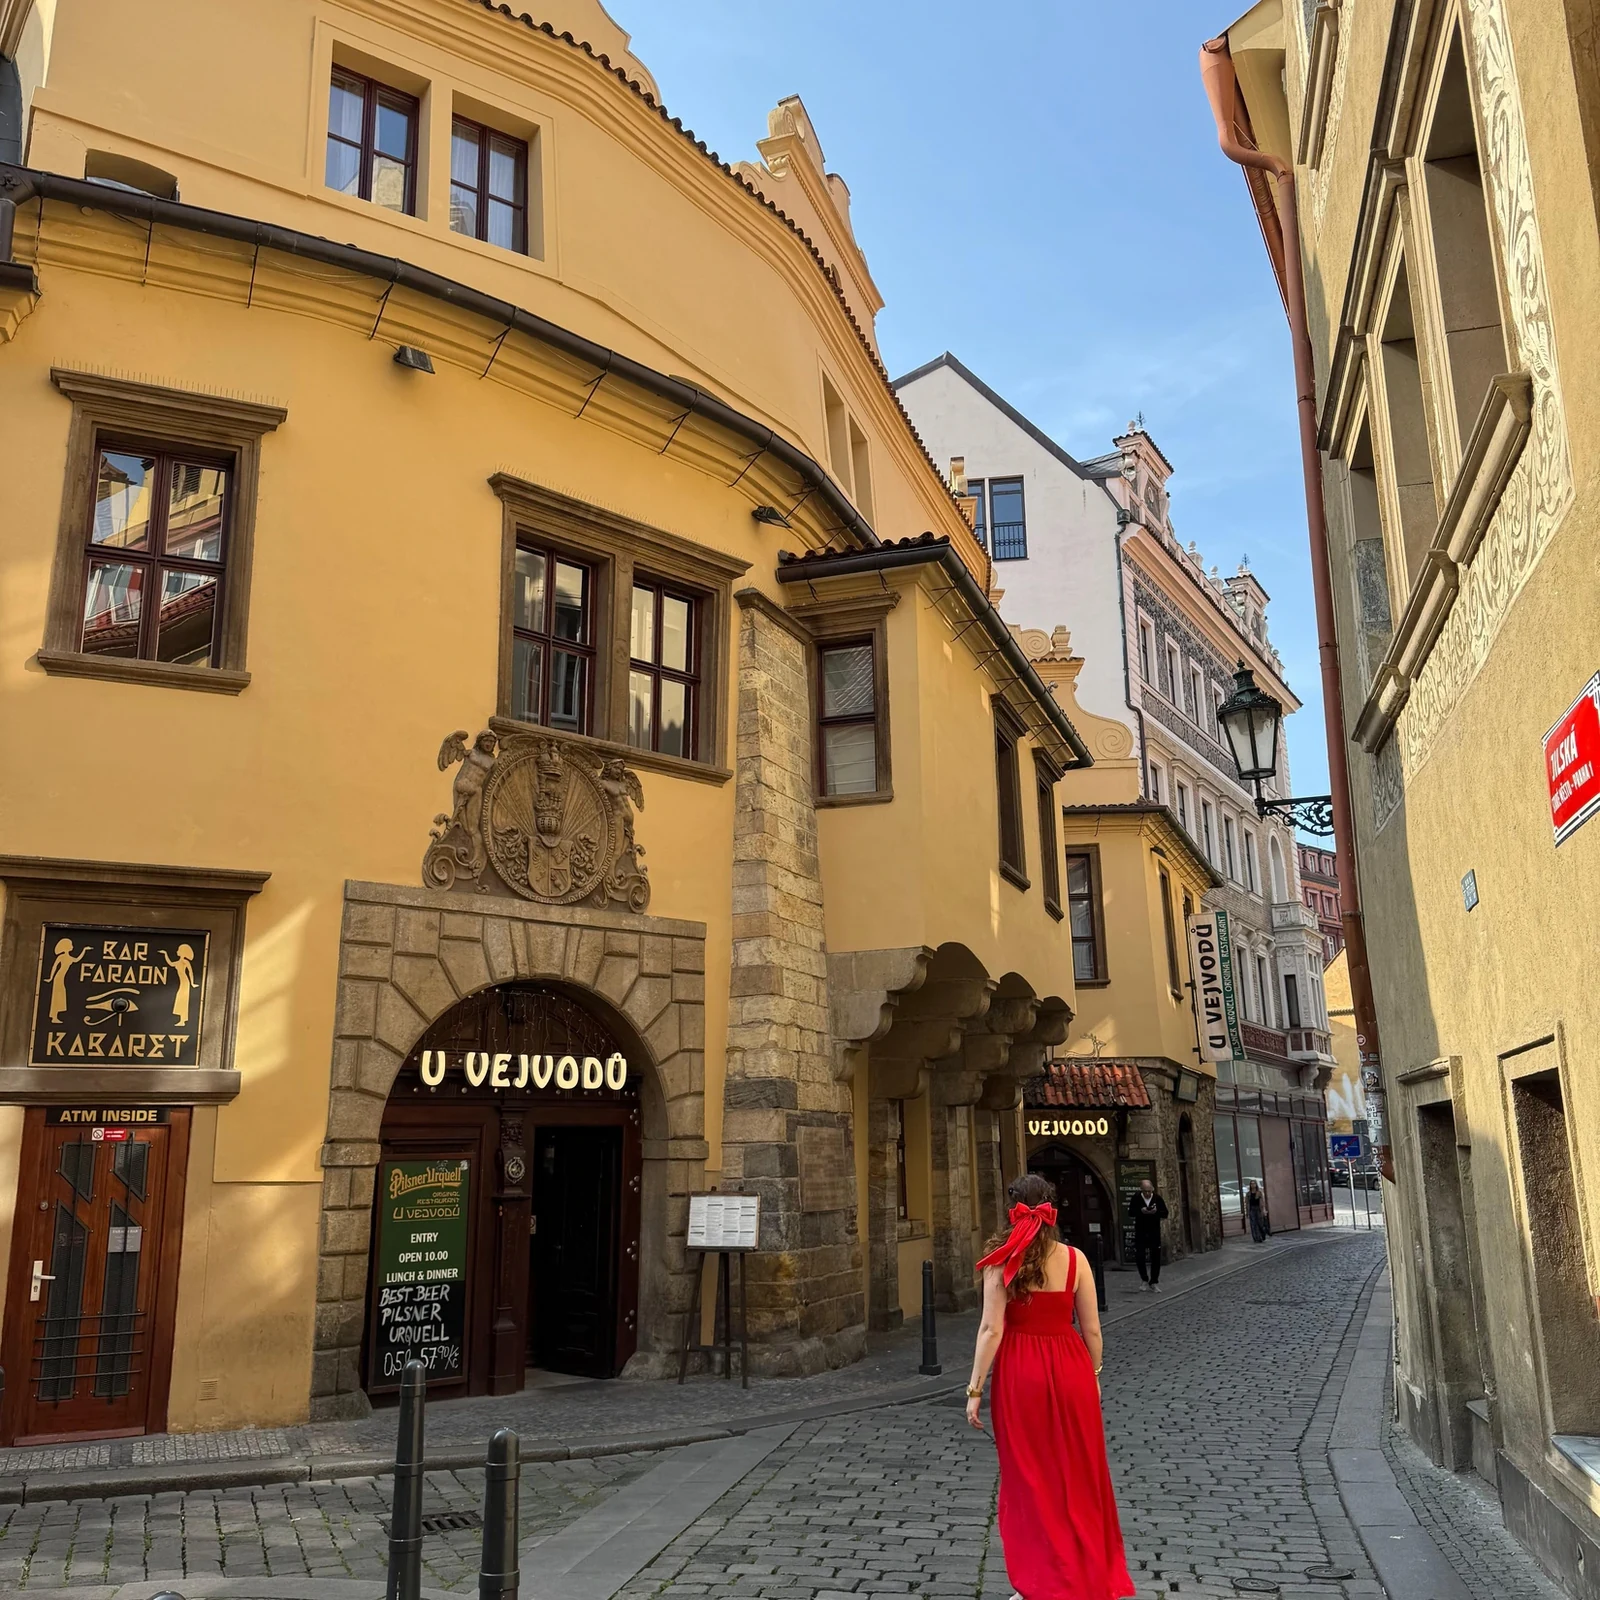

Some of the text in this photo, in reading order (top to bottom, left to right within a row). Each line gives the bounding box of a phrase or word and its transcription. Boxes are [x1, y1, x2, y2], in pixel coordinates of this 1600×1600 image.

[1550, 723, 1579, 782] JILSKÁ
[103, 940, 149, 961] BAR
[79, 963, 168, 985] FARAON
[1220, 959, 1233, 991] ORIGINAL
[1190, 923, 1226, 1049] U VEJVODŮ
[46, 1031, 190, 1058] KABARET
[1230, 1027, 1242, 1056] PILSNER
[420, 1050, 627, 1091] U VEJVODŮ
[60, 1109, 157, 1122] ATM INSIDE
[1028, 1117, 1109, 1136] VEJVODŮ
[389, 1168, 428, 1199] Pilsner
[427, 1166, 461, 1188] Urquell
[392, 1207, 404, 1219] U
[410, 1232, 439, 1243] ENTRY
[398, 1250, 448, 1263] OPEN 10.00
[386, 1268, 458, 1283] LUNCH & DINNER
[379, 1284, 451, 1307] BEST BEER
[381, 1303, 442, 1326] PILSNER
[389, 1323, 450, 1346] URQUELL
